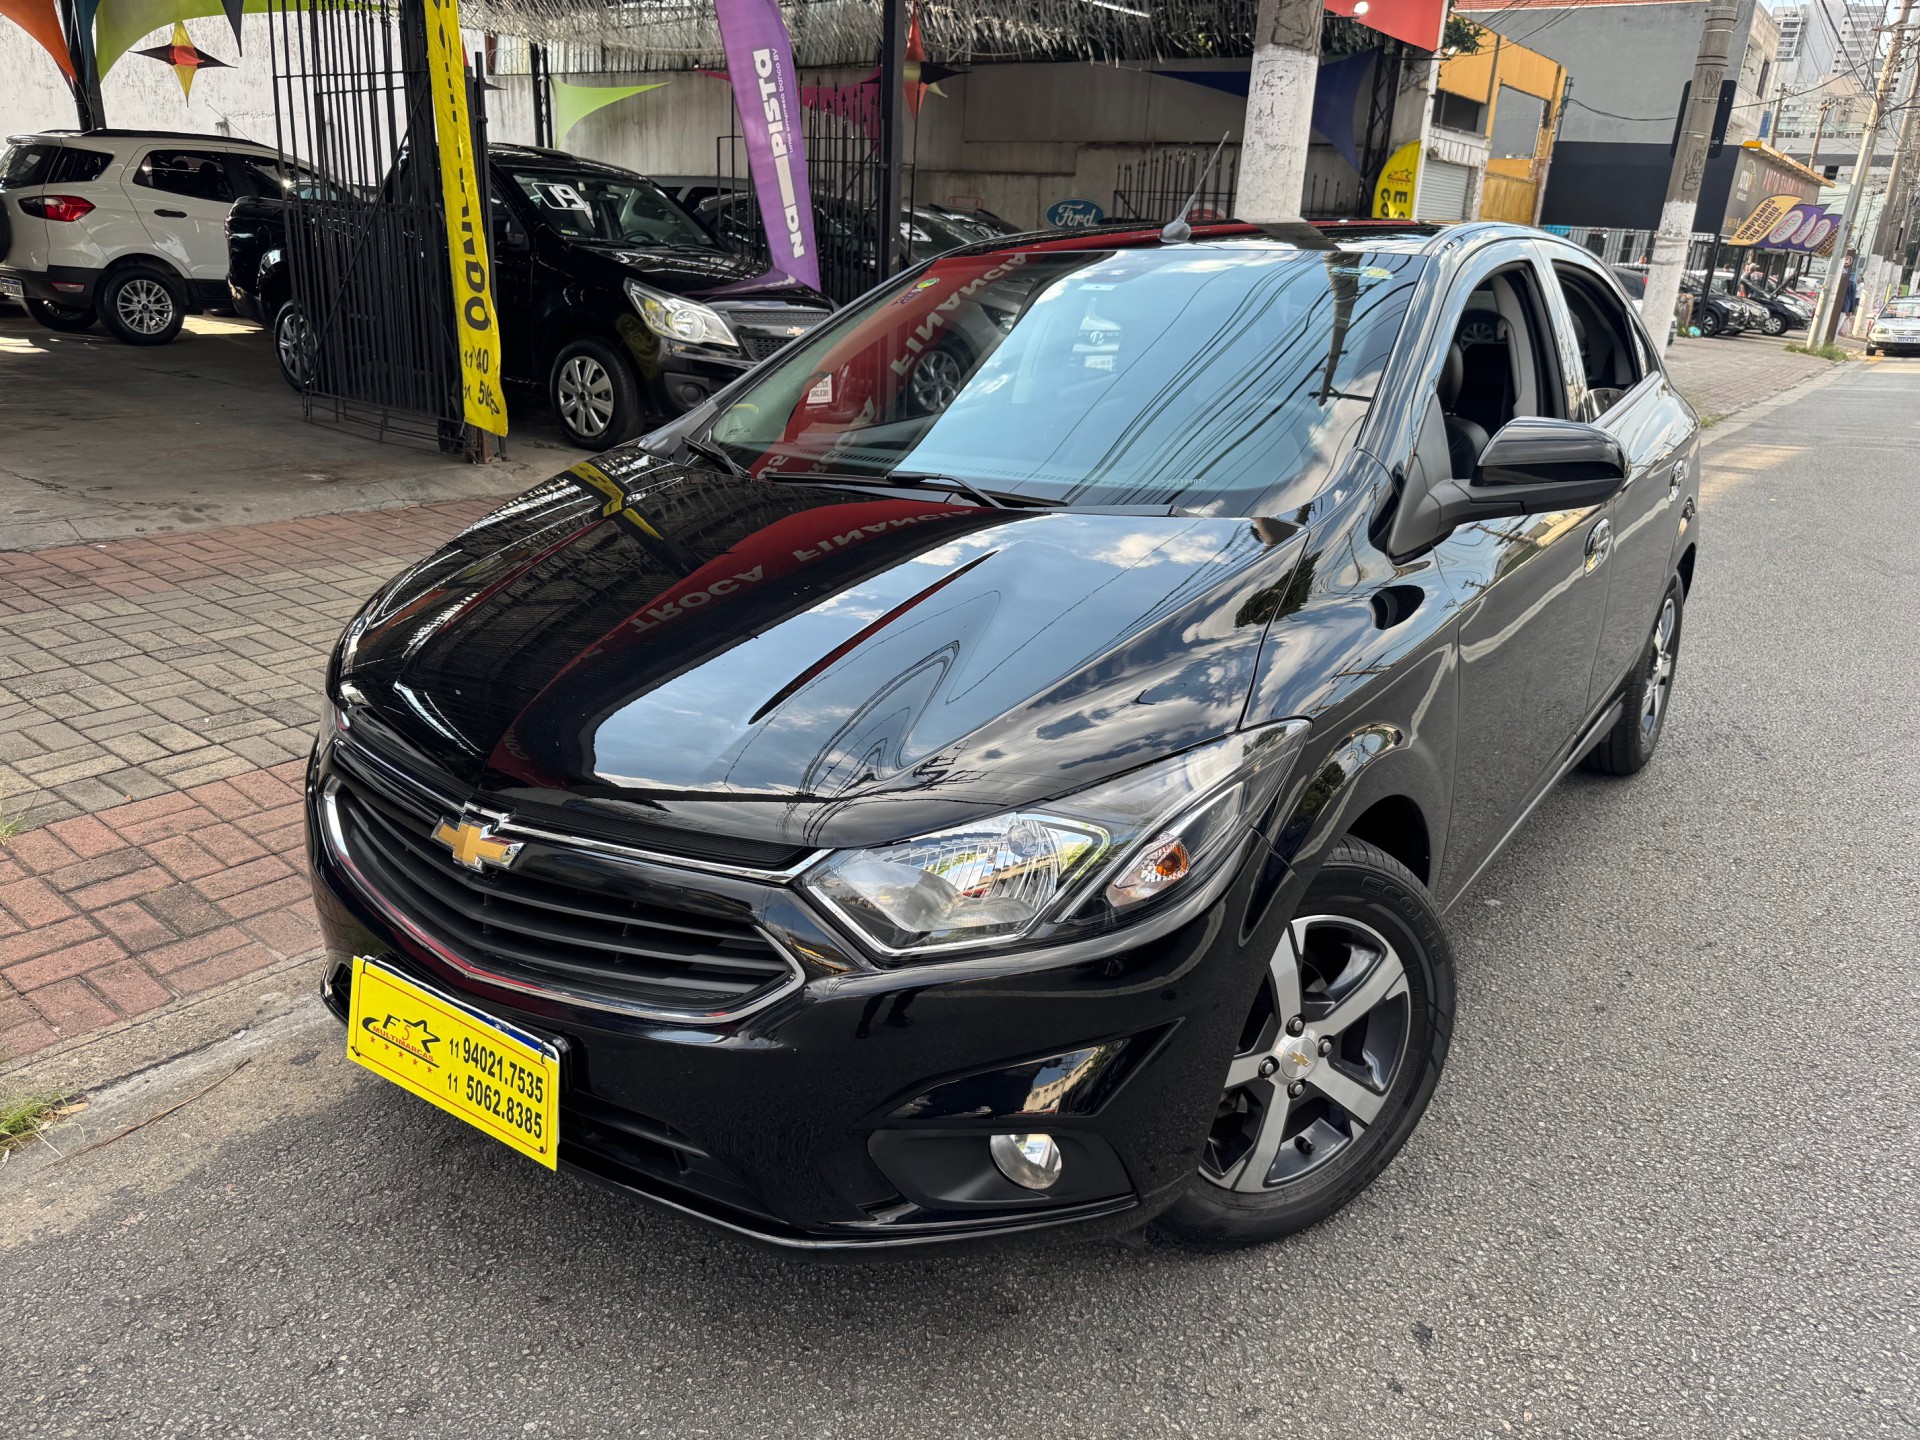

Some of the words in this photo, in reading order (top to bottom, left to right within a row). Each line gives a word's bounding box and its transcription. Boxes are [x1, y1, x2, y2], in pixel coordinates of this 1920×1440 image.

[771, 48, 781, 62] BV
[775, 62, 785, 92] banco
[780, 93, 791, 132] empresa
[786, 132, 794, 154] uma
[548, 185, 586, 208] 19
[1055, 204, 1098, 227] Ford
[1736, 198, 1776, 241] COMPRAMOS
[1745, 226, 1760, 242] SEU
[372, 1025, 435, 1062] MULTIMARCAS
[449, 1037, 460, 1059] 11
[463, 1036, 544, 1104] 94021.7535
[447, 1072, 459, 1094] 11
[466, 1074, 543, 1139] 5062.8385
